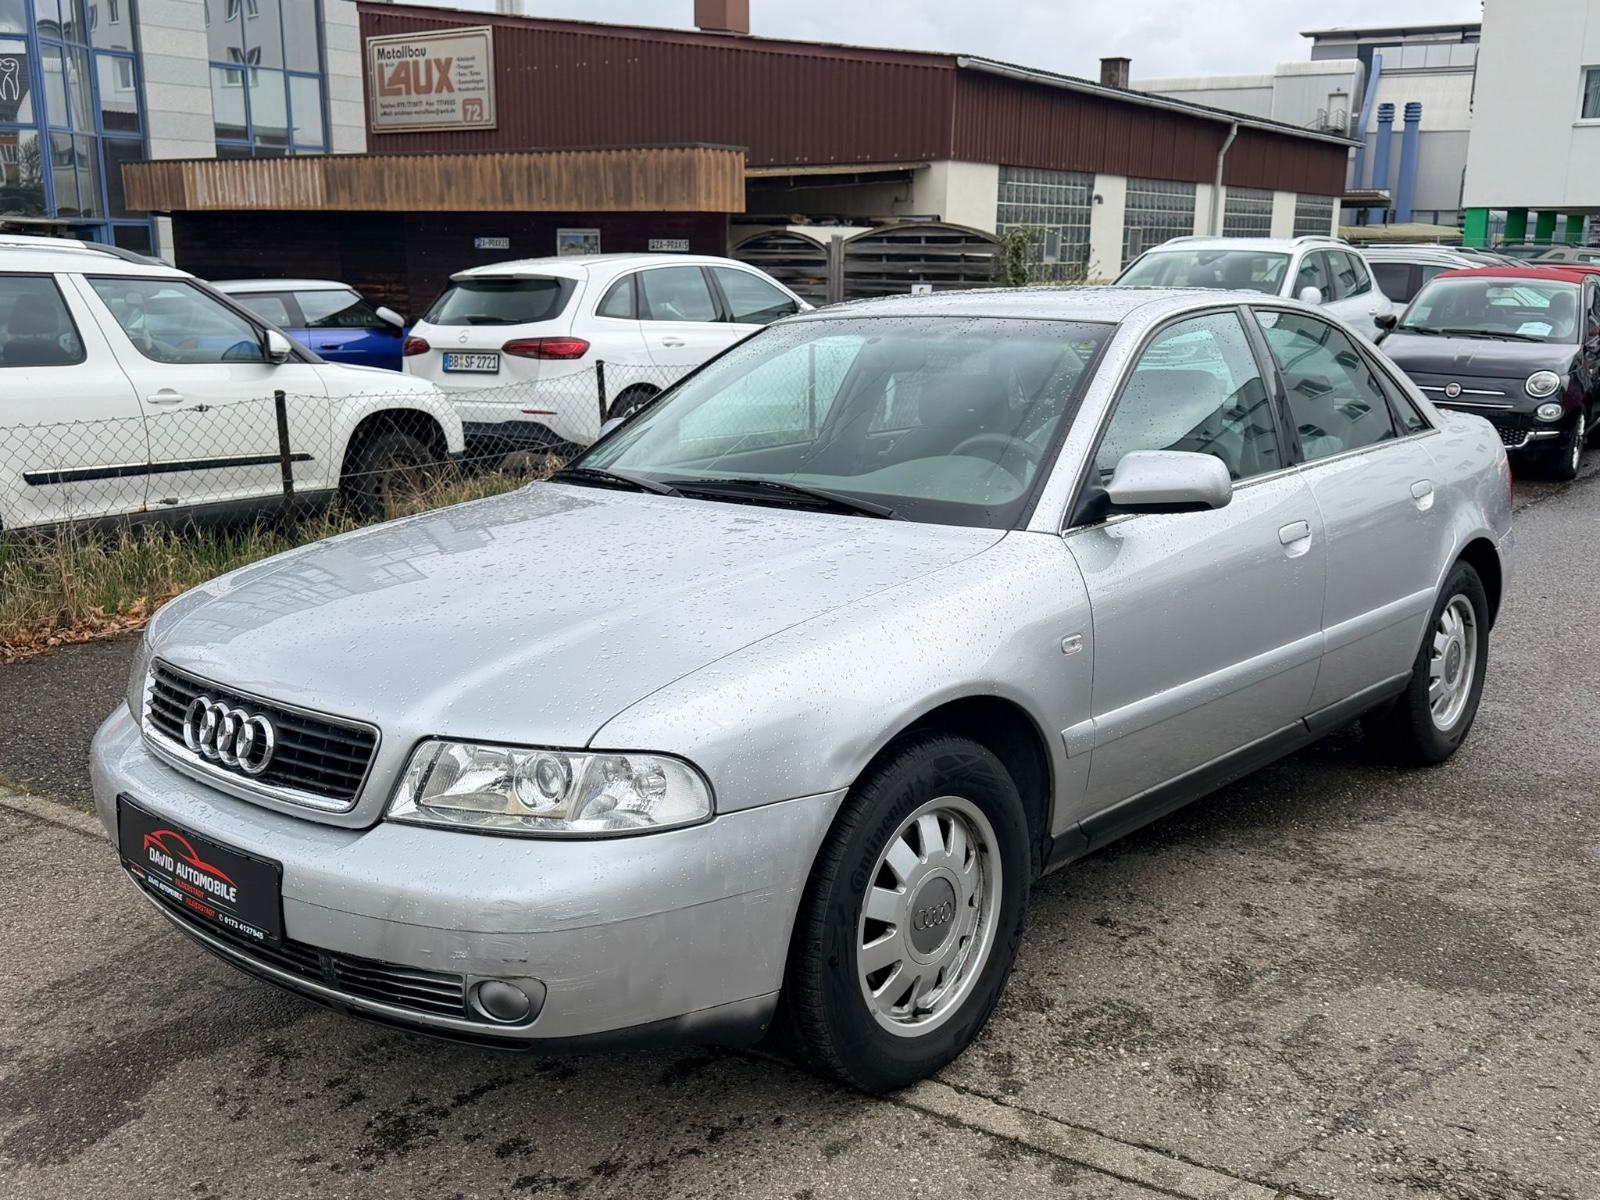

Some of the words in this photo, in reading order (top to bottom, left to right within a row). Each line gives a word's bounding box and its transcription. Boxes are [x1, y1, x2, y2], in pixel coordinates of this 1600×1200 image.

[377, 46, 426, 60] Metallbau
[377, 57, 455, 96] LAUX
[465, 105, 480, 121] 72
[448, 355, 459, 368] BB
[465, 355, 475, 368] SF
[476, 356, 496, 368] 2721
[149, 848, 174, 872] DAVID
[176, 862, 237, 903] AUTOMOBILE
[224, 917, 239, 929] 0173
